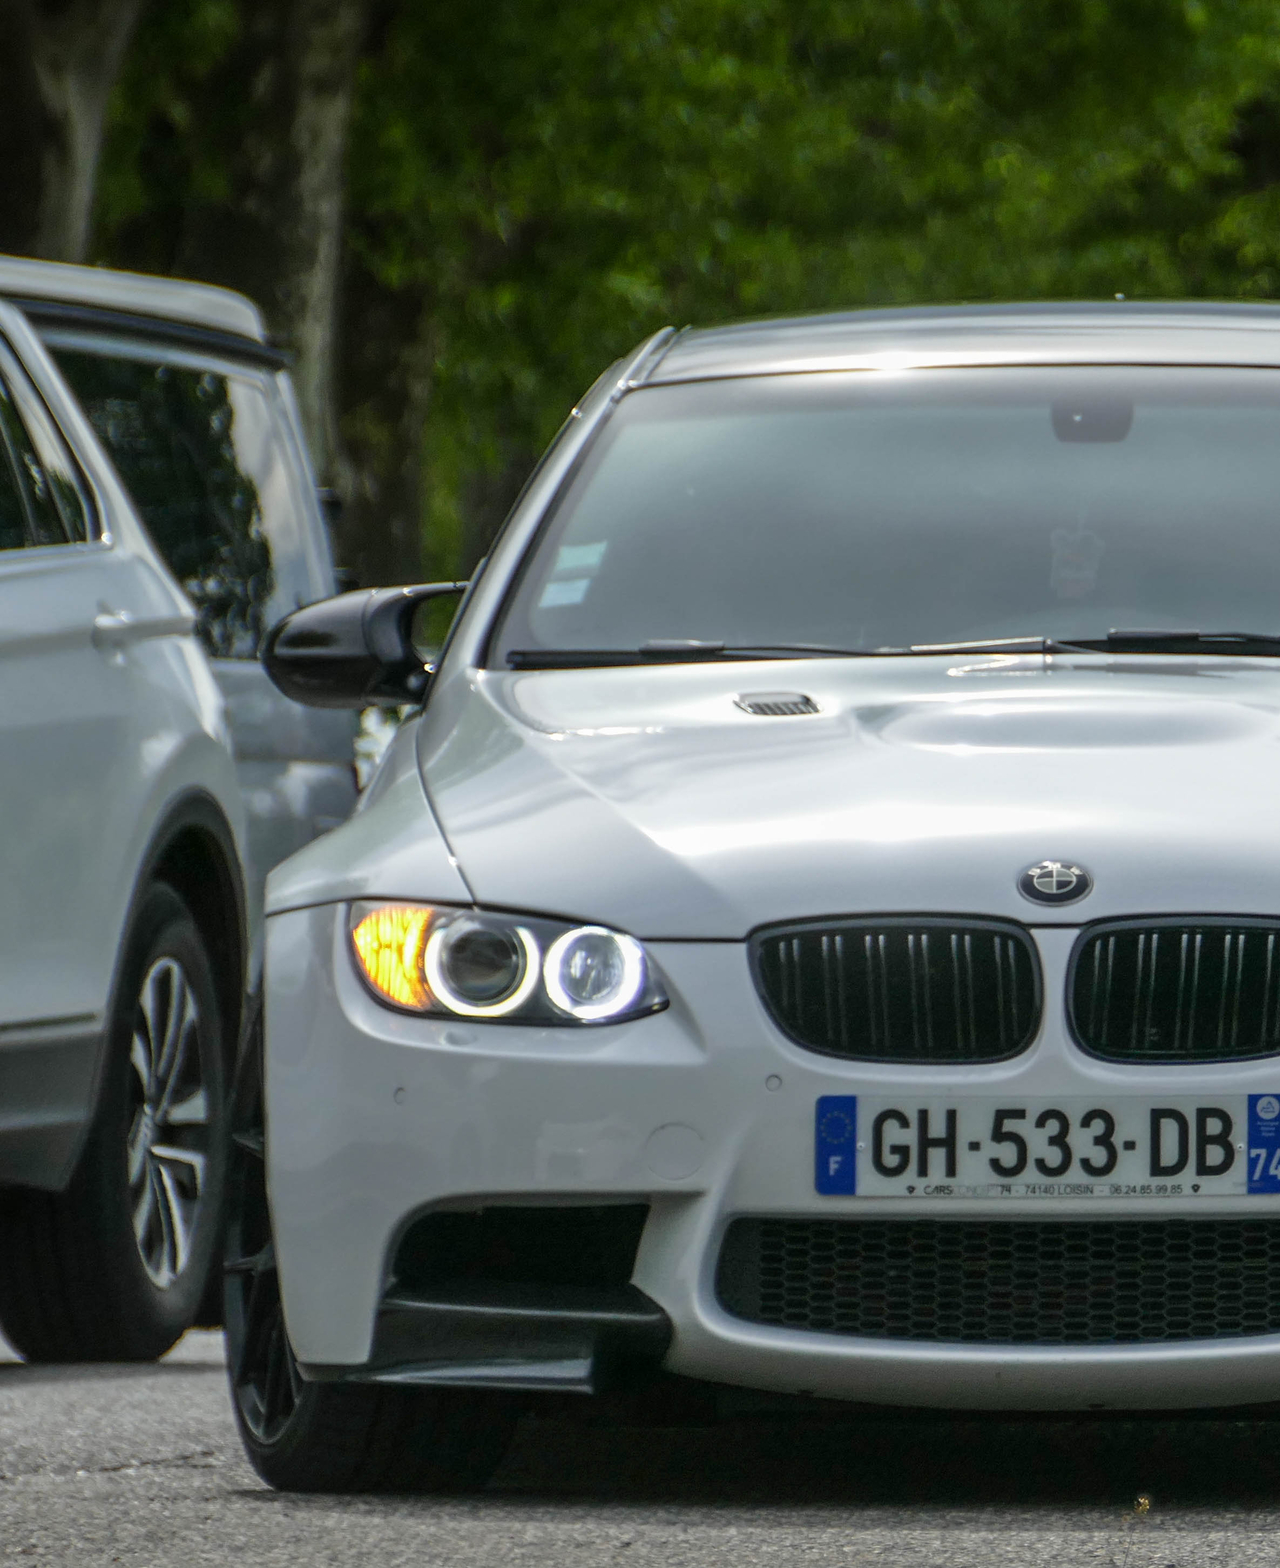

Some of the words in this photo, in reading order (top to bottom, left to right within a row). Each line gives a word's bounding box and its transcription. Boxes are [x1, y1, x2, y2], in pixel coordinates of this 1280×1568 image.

[872, 1108, 1236, 1178] GH-533-DB
[829, 1155, 842, 1176] F
[1024, 1184, 1055, 1196] 74140
